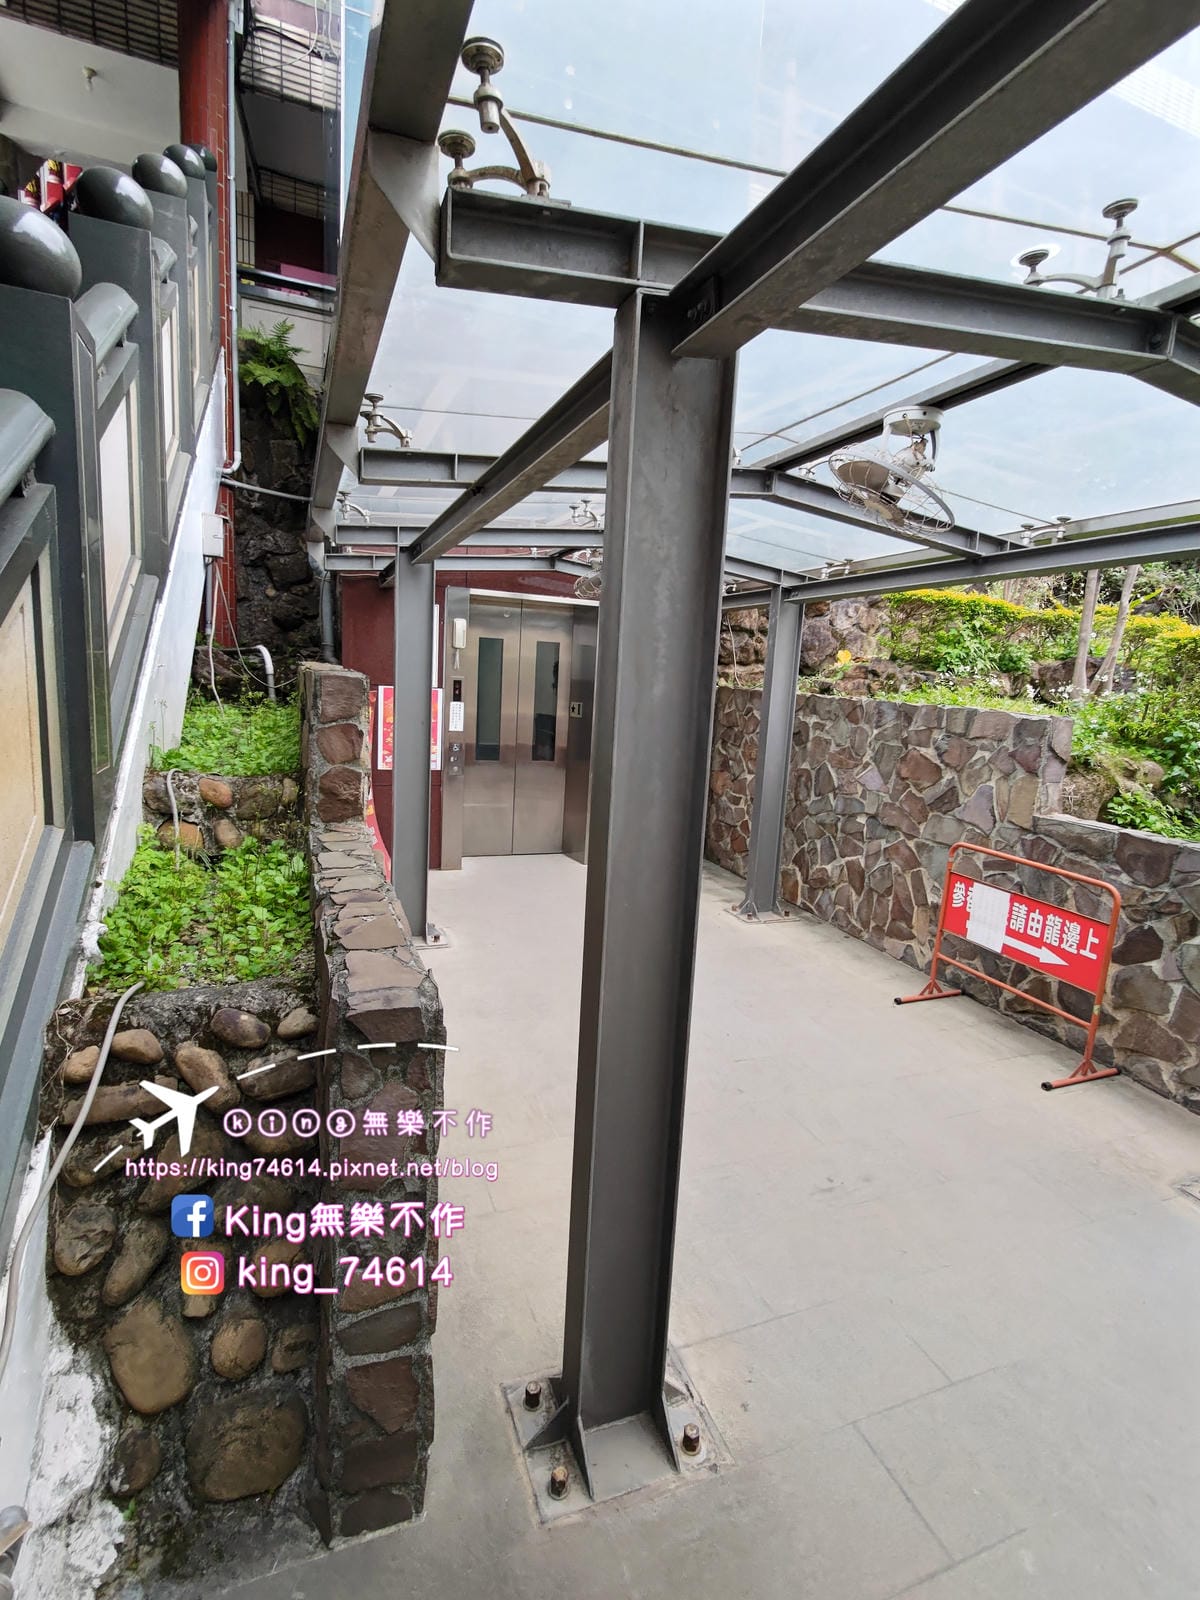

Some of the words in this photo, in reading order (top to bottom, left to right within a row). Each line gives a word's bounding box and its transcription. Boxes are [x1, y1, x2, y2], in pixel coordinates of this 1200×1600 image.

[1009, 901, 1100, 960] 請由龍邊上
